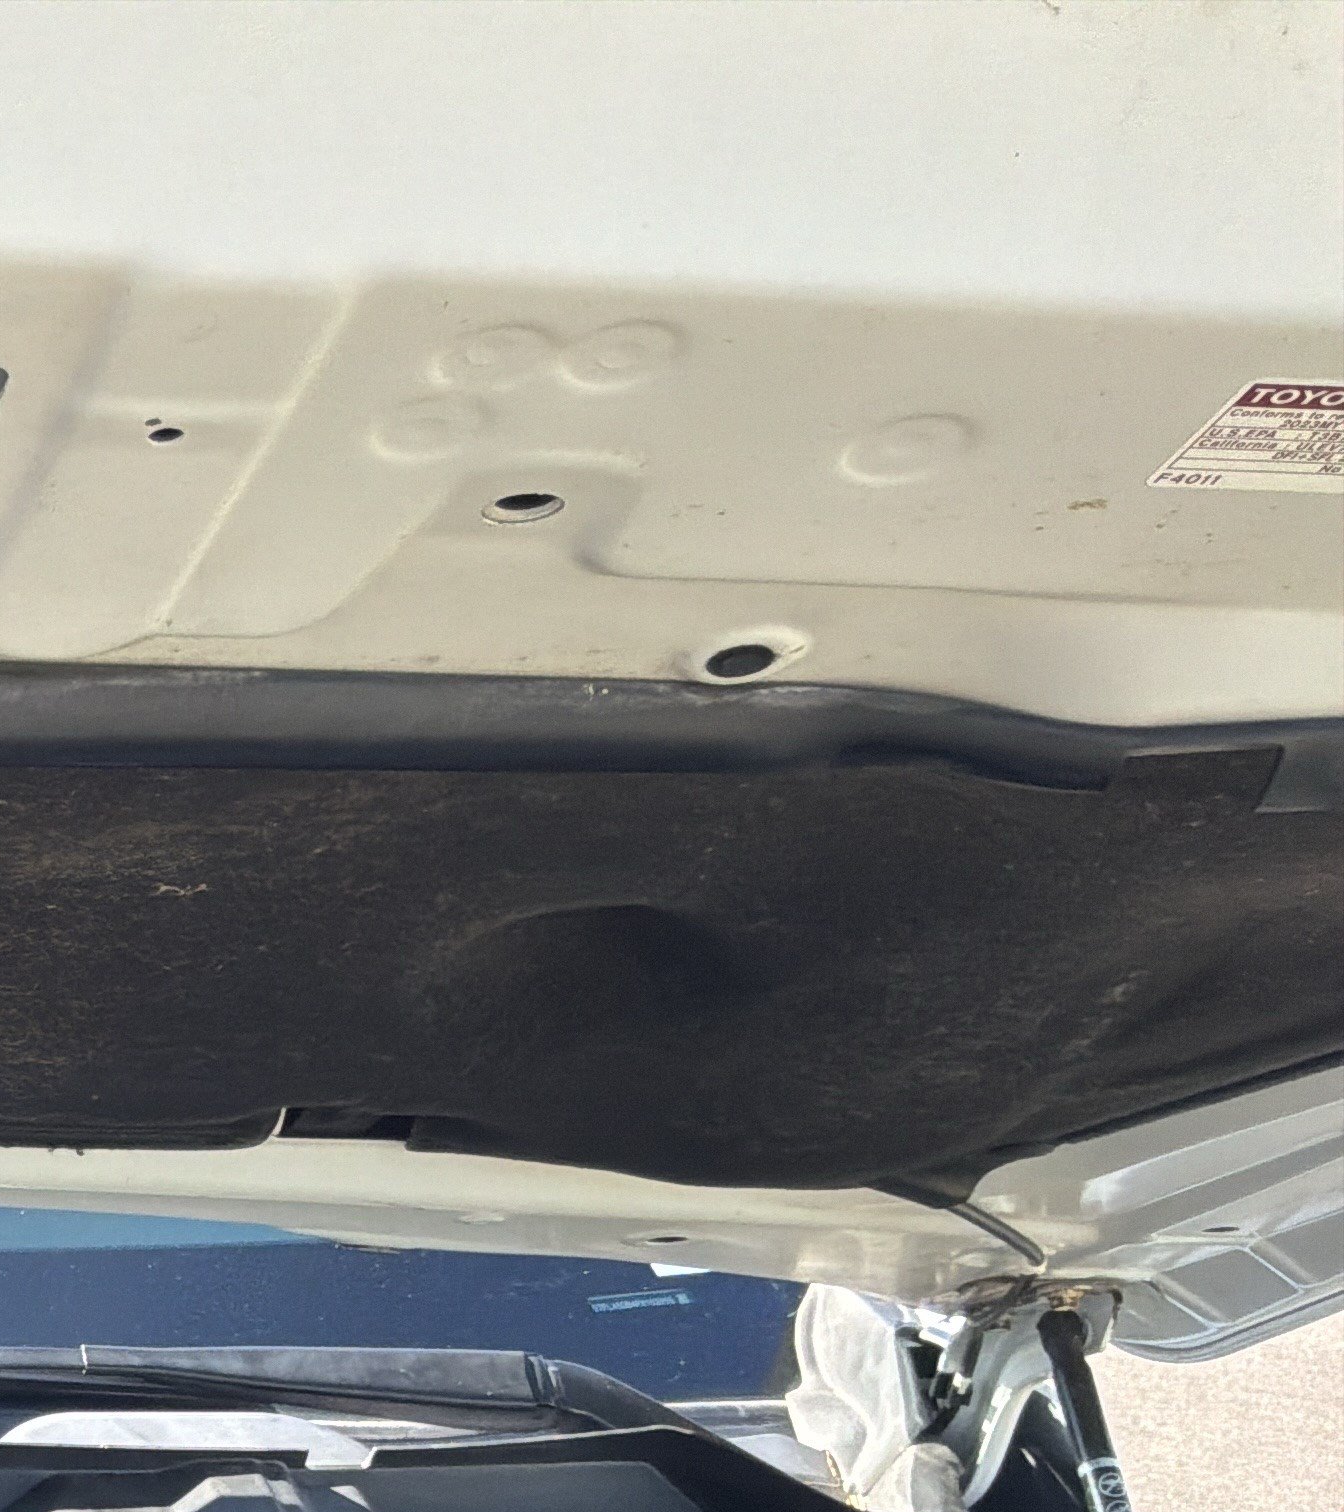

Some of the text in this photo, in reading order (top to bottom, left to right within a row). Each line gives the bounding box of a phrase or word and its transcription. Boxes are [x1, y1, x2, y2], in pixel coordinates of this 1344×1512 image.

[1230, 408, 1304, 419] Conforms
[1310, 411, 1325, 420] to
[1279, 419, 1341, 429] 2023MY
[1209, 428, 1278, 438] U.S.EPA
[1198, 438, 1278, 450] California
[1319, 464, 1342, 473] No
[1153, 473, 1223, 486] F4011
